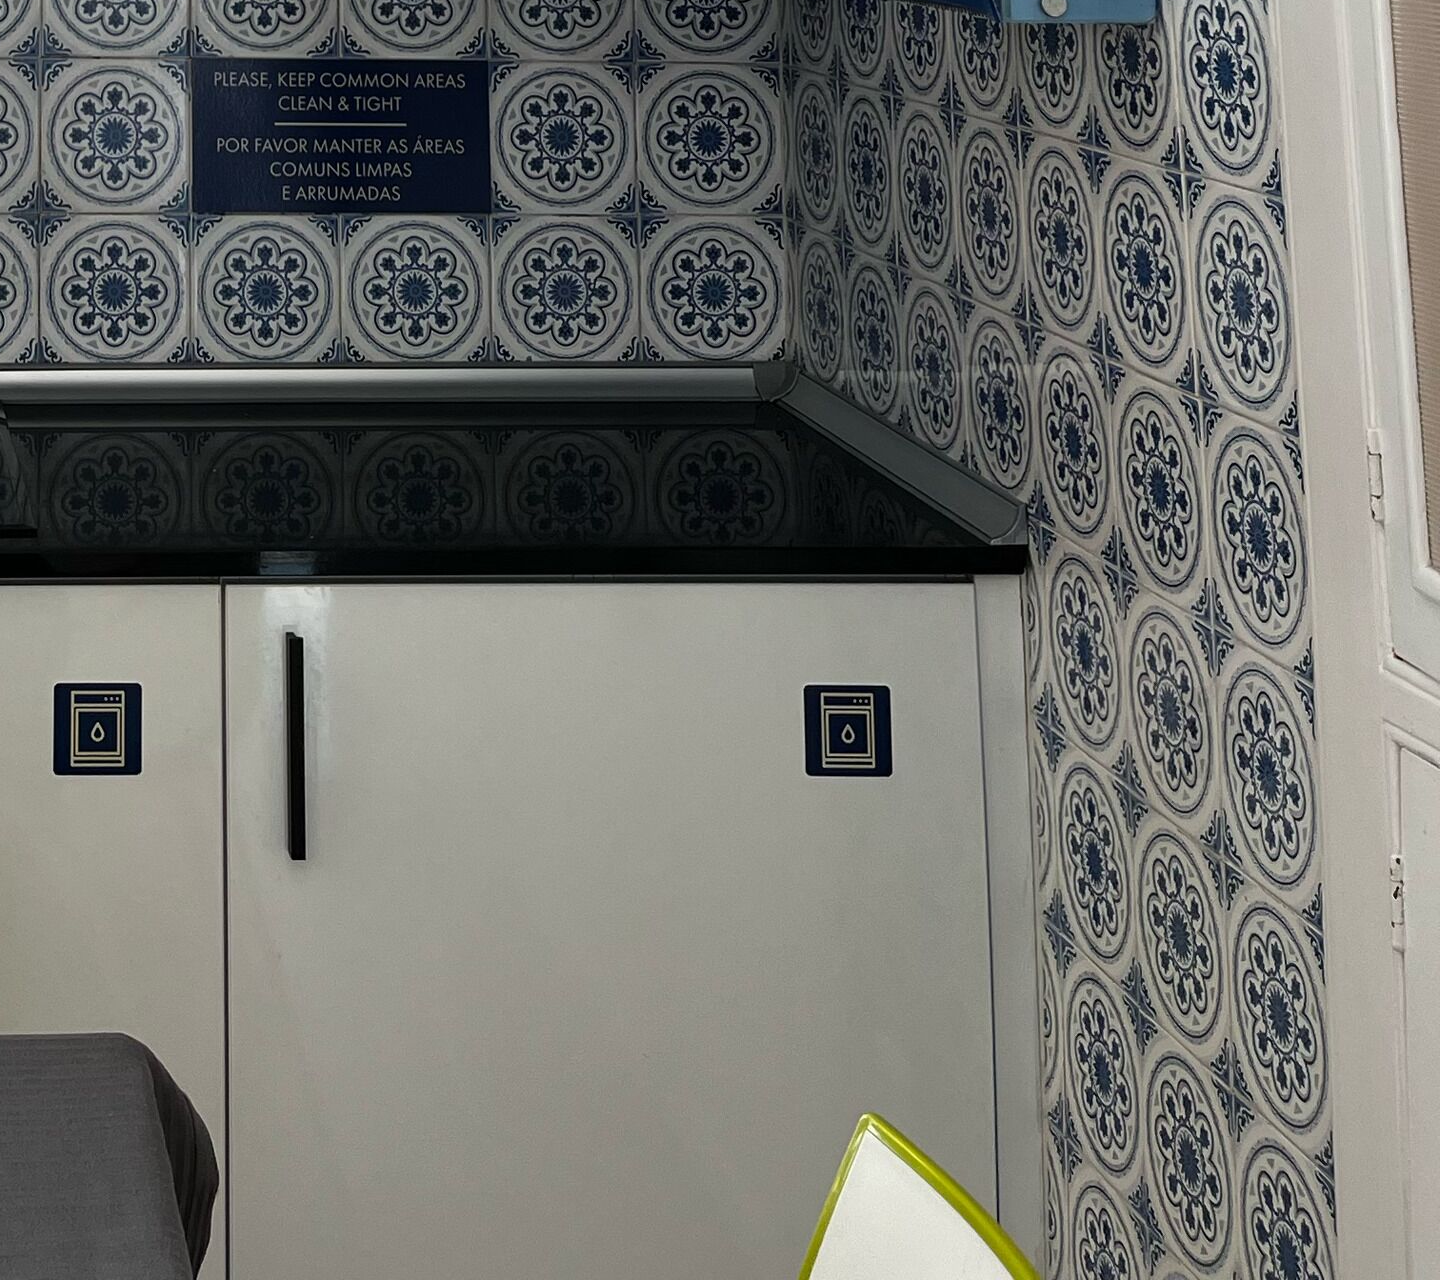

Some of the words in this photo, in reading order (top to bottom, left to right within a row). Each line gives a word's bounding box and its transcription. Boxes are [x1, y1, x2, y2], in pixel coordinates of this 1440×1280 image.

[214, 72, 272, 89] PLEASE,
[278, 72, 316, 87] KEEP
[319, 73, 408, 88] COMMON
[414, 74, 466, 88] AREAS
[278, 96, 332, 111] CLEAN
[338, 96, 350, 111] &
[354, 96, 402, 111] TIGHT
[217, 138, 250, 153] POR
[255, 138, 308, 153] FAVOR
[313, 138, 382, 154] MANTER
[386, 139, 408, 154] AS
[412, 134, 464, 154] ÁREAS
[270, 162, 350, 177] COMUNS
[355, 162, 412, 178] LIMPAS
[282, 186, 291, 200] E
[295, 186, 400, 201] ARRUMADAS
